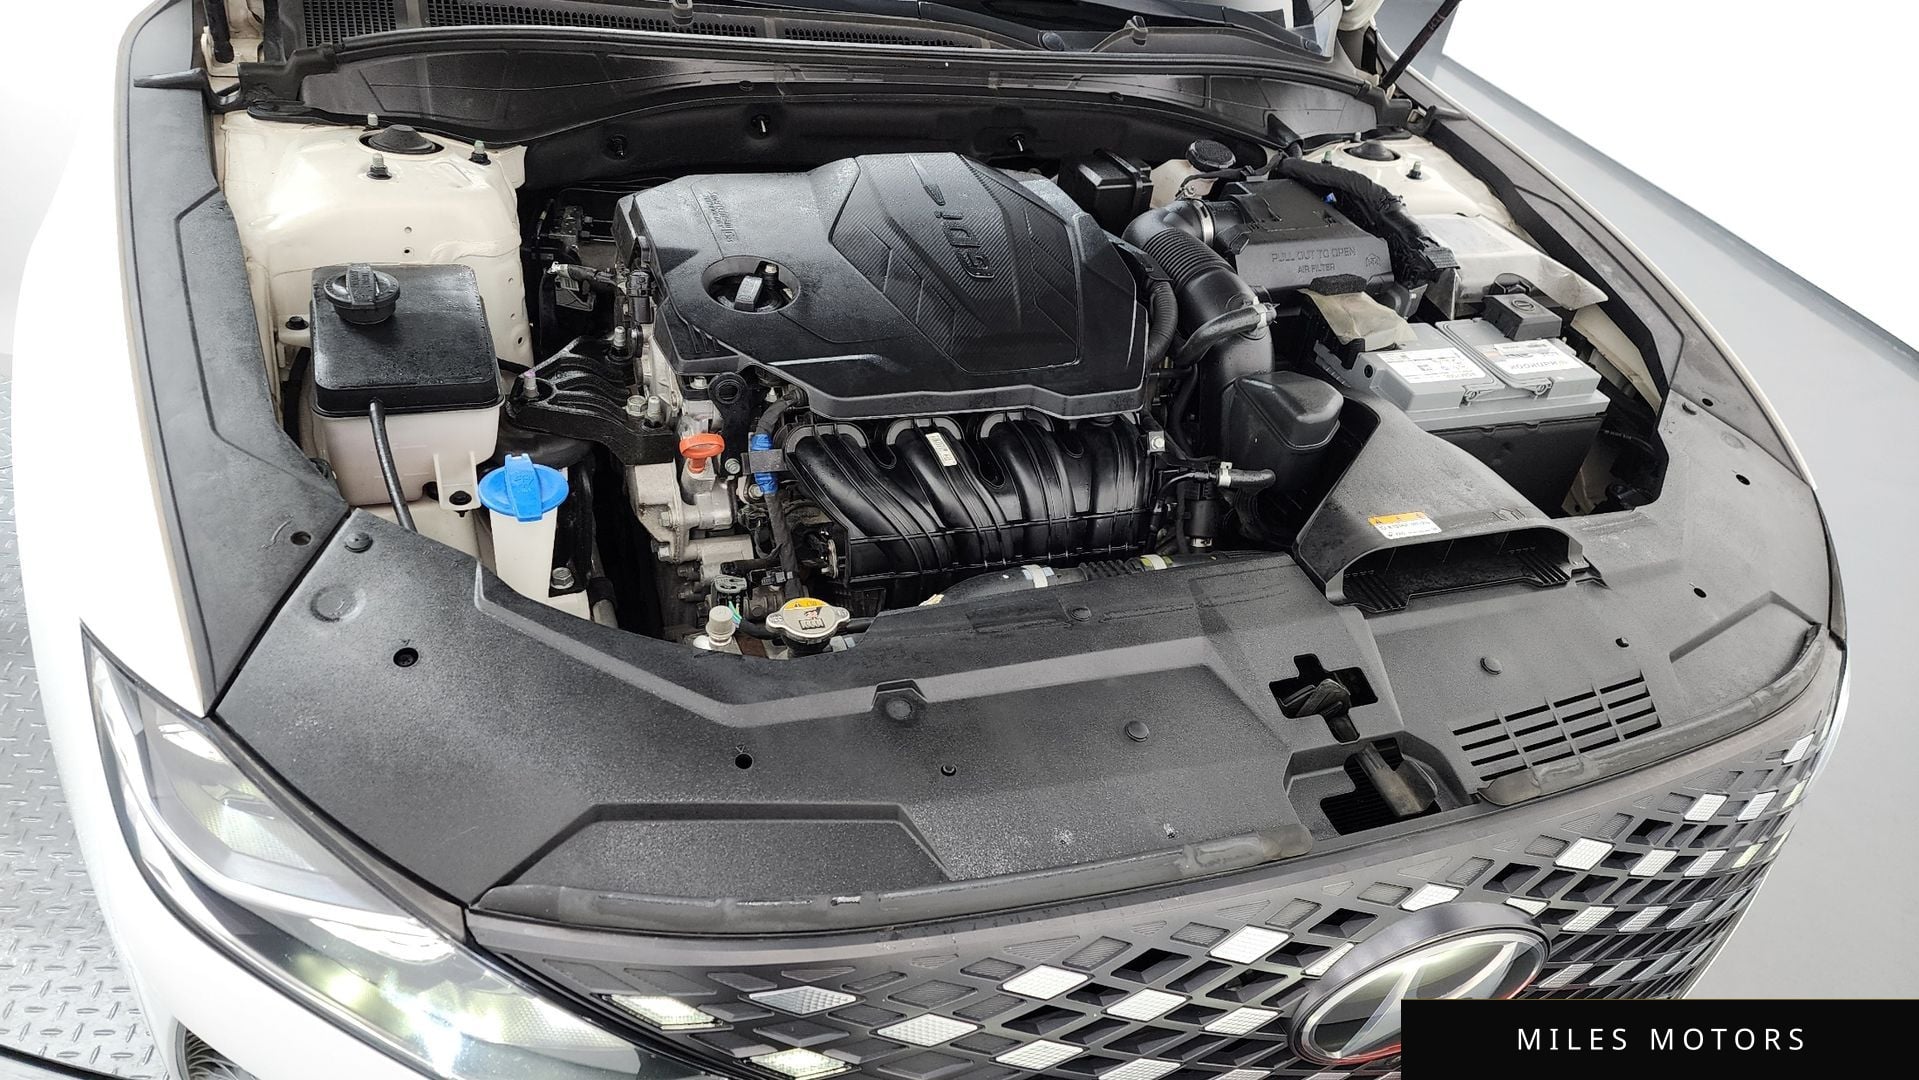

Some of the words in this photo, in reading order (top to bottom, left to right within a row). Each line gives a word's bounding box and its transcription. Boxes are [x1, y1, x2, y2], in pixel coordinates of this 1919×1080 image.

[1271, 252, 1295, 263] PULL
[1297, 250, 1315, 261] OUT
[1316, 249, 1330, 259] TO
[1332, 247, 1357, 257] OPEN
[1297, 264, 1310, 274] AIR
[1312, 263, 1336, 273] FILTER
